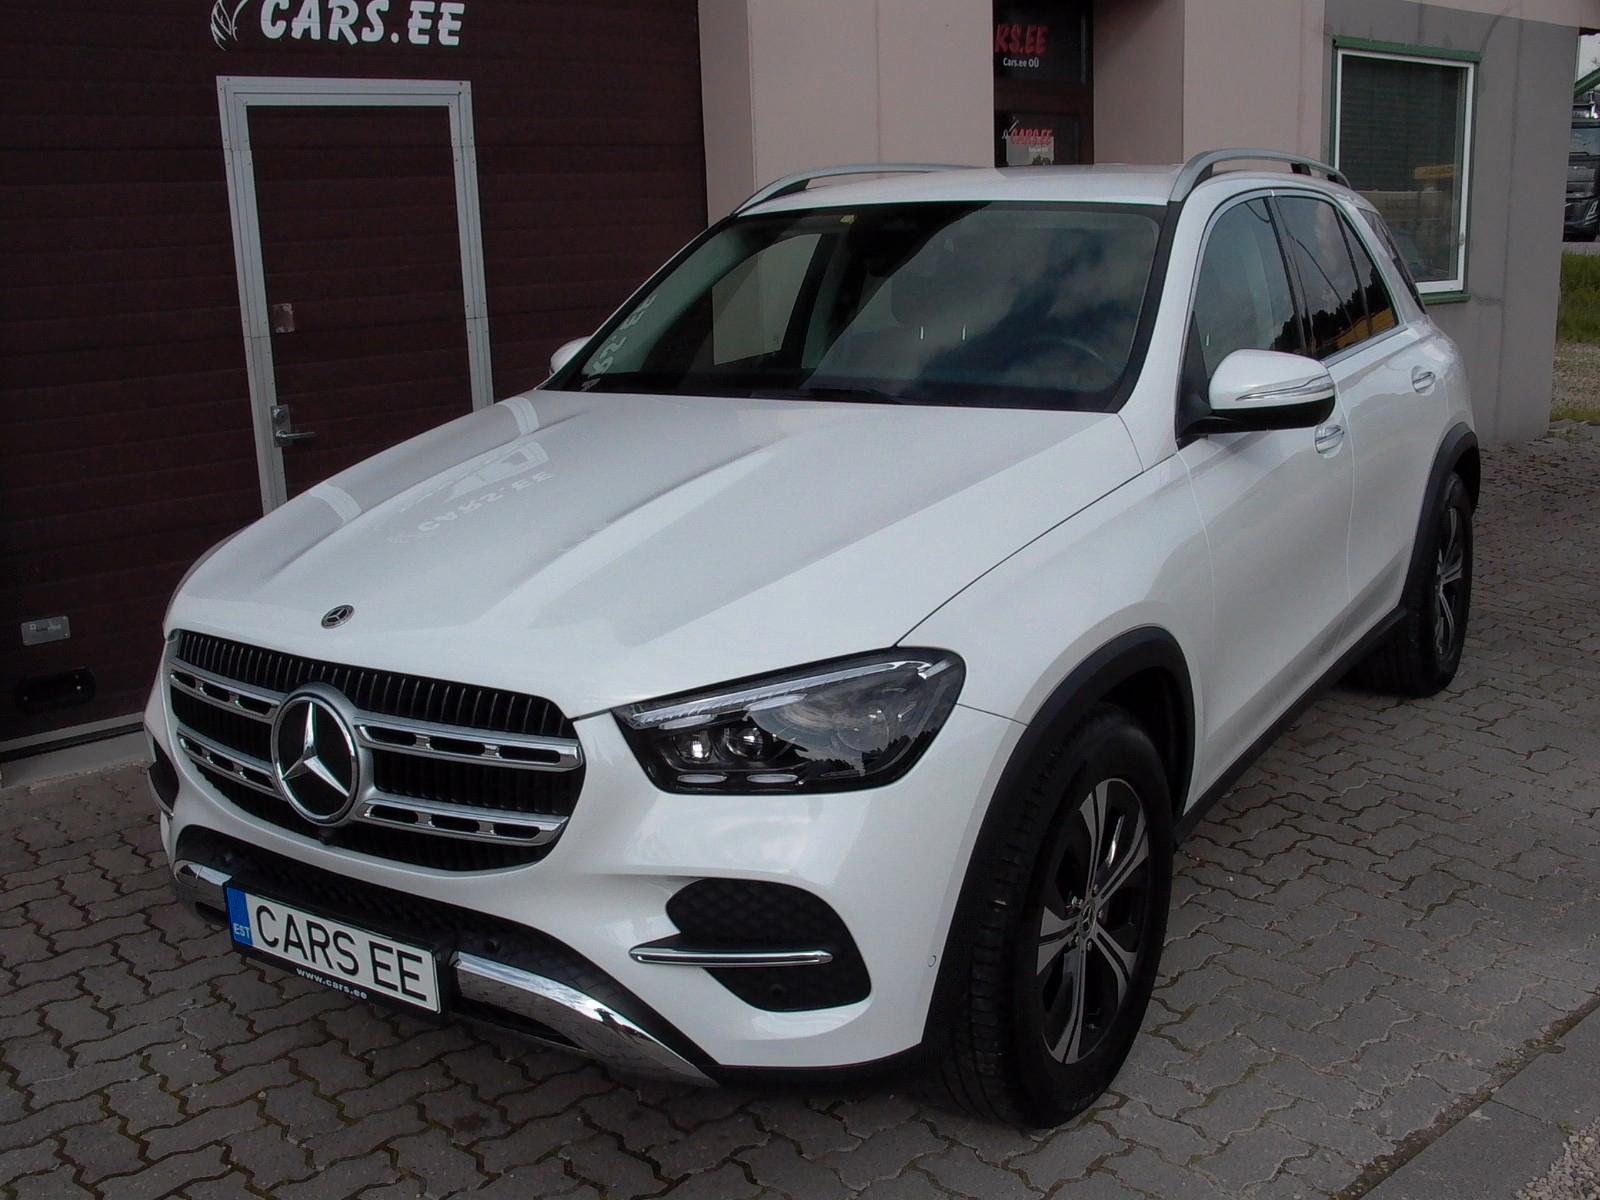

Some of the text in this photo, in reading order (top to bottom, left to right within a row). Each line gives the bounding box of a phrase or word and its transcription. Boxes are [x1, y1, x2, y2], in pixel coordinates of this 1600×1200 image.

[260, 0, 465, 46] CARS.EE
[994, 23, 1048, 54] RS.EE
[233, 922, 250, 939] EST
[256, 905, 428, 1002] CARS EE
[296, 967, 368, 1000] www.cars.ee
